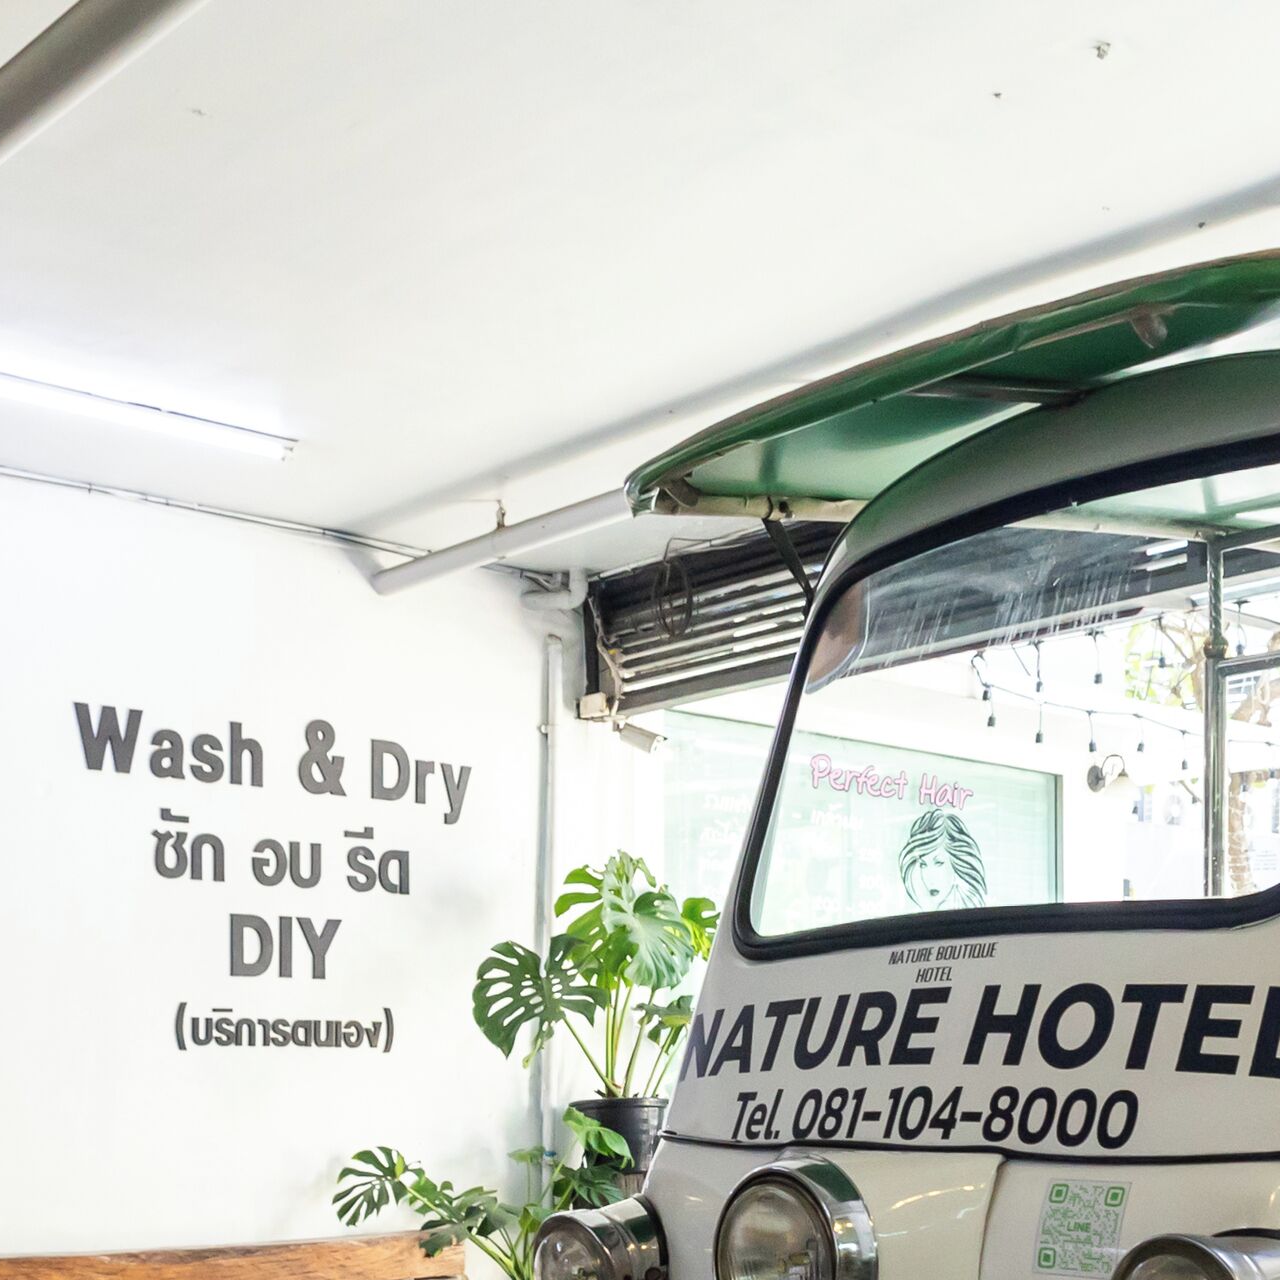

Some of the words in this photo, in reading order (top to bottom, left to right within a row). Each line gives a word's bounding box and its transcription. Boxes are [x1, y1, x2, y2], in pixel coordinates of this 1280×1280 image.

[73, 701, 264, 788] Wash
[298, 719, 347, 797] &
[370, 738, 472, 825] Dry
[810, 754, 909, 799] Perfect
[919, 773, 974, 810] Hair
[151, 808, 226, 883] ซัก
[251, 838, 322, 889] อบ
[343, 826, 411, 896] รีด
[229, 912, 343, 980] DIY
[888, 946, 935, 965] NATURE
[935, 942, 999, 961] BOUTIQUE
[915, 966, 952, 983] HOTEL
[680, 986, 952, 1082] NATURE
[731, 1089, 784, 1140] Tel.
[792, 1085, 1139, 1149] 081-104-8000
[1066, 1221, 1091, 1233] LINE
